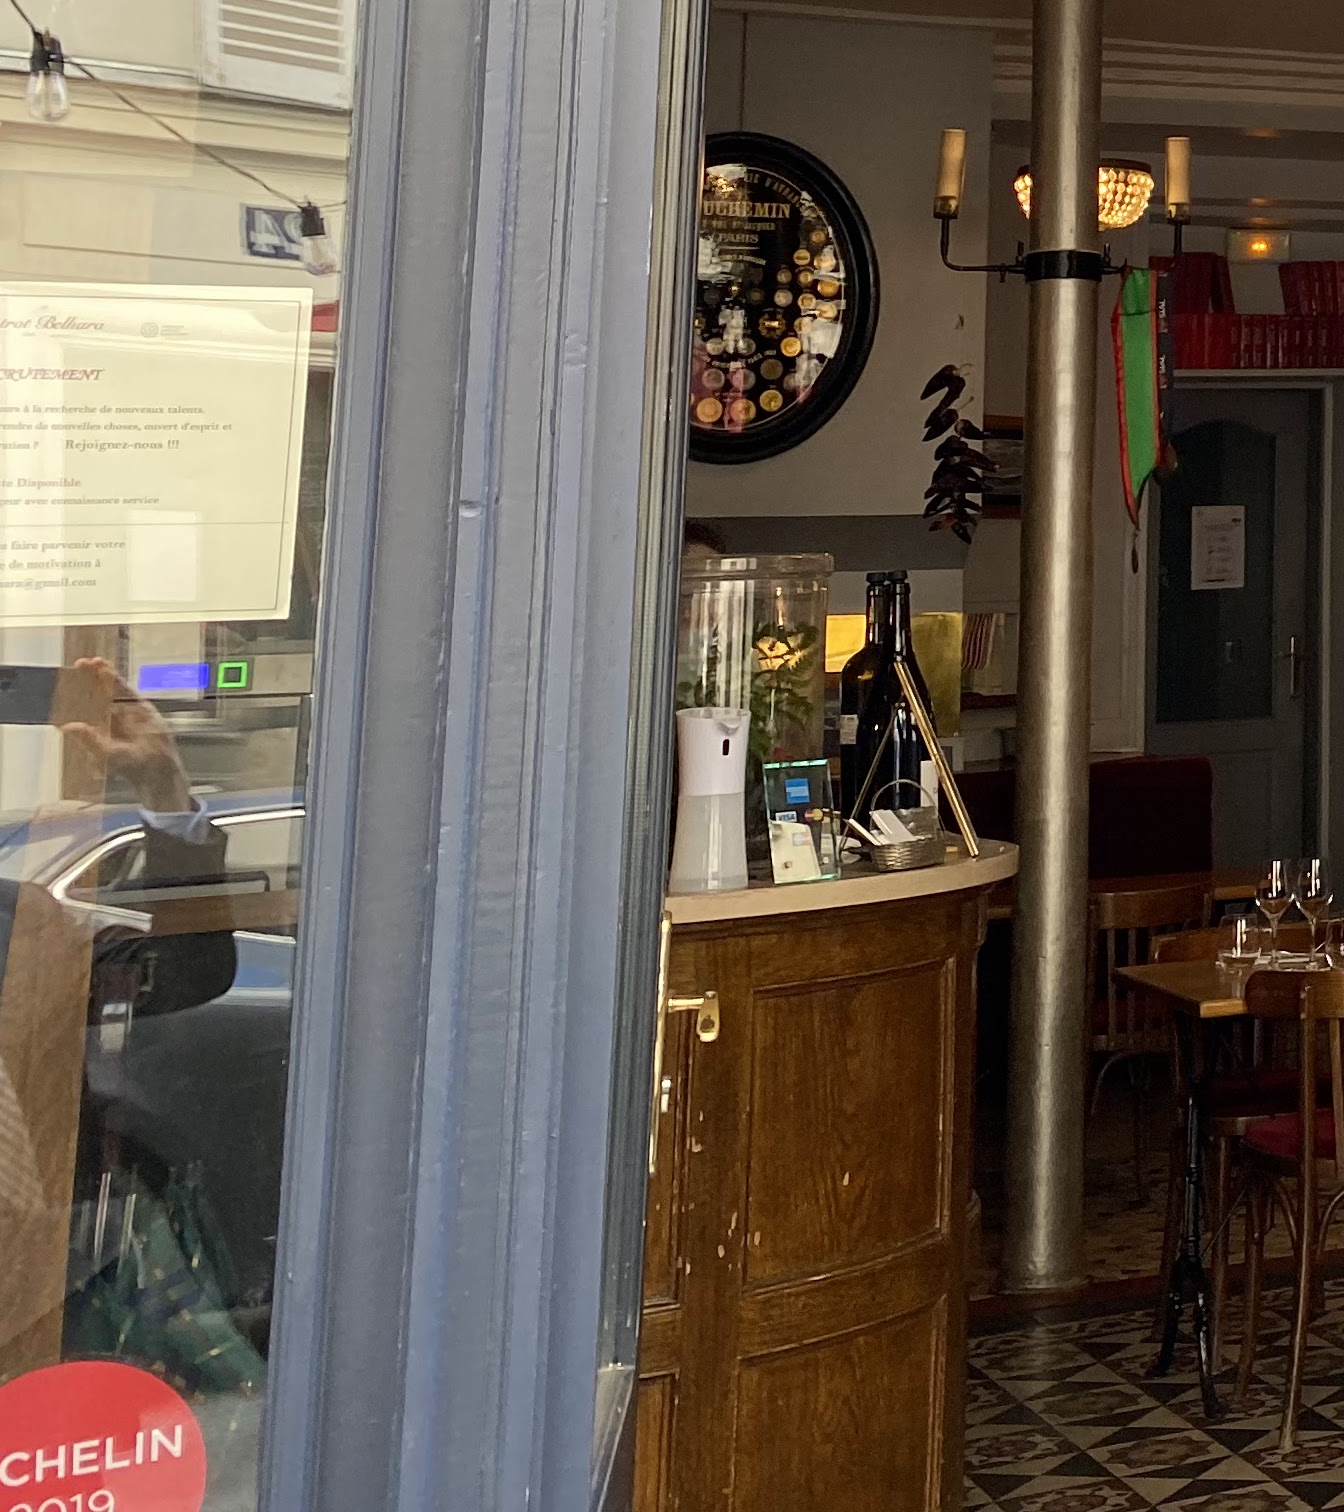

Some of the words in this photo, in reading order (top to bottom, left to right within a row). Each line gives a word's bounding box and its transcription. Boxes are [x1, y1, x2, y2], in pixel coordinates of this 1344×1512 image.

[35, 316, 105, 331] Belhara
[45, 405, 97, 414] recherche
[99, 405, 113, 414] de
[64, 439, 163, 453] Rejoignez-nous
